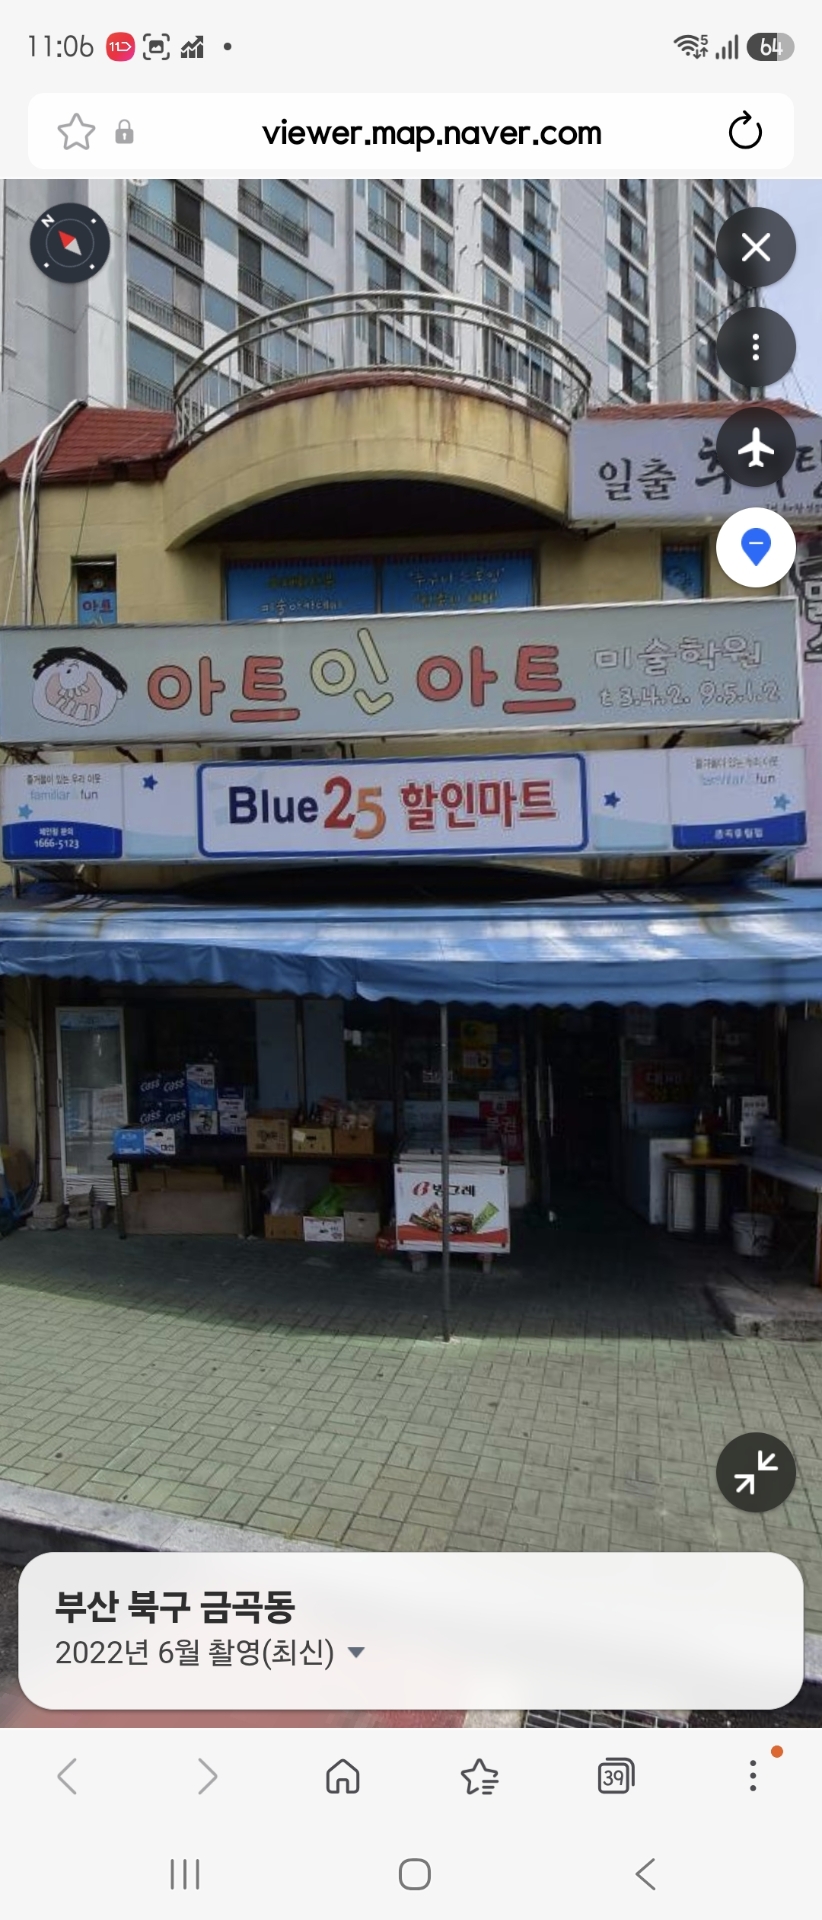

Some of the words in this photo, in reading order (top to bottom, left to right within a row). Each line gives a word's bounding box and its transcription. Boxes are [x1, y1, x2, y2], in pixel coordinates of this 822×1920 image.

[598, 457, 677, 502] 일출
[147, 655, 300, 723] 아트
[309, 628, 394, 715] 인
[416, 645, 577, 715] 아트
[594, 636, 763, 677] 미술학원
[80, 789, 99, 801] fun
[400, 779, 558, 832] 할인마트
[34, 838, 80, 850] 1666-5123
